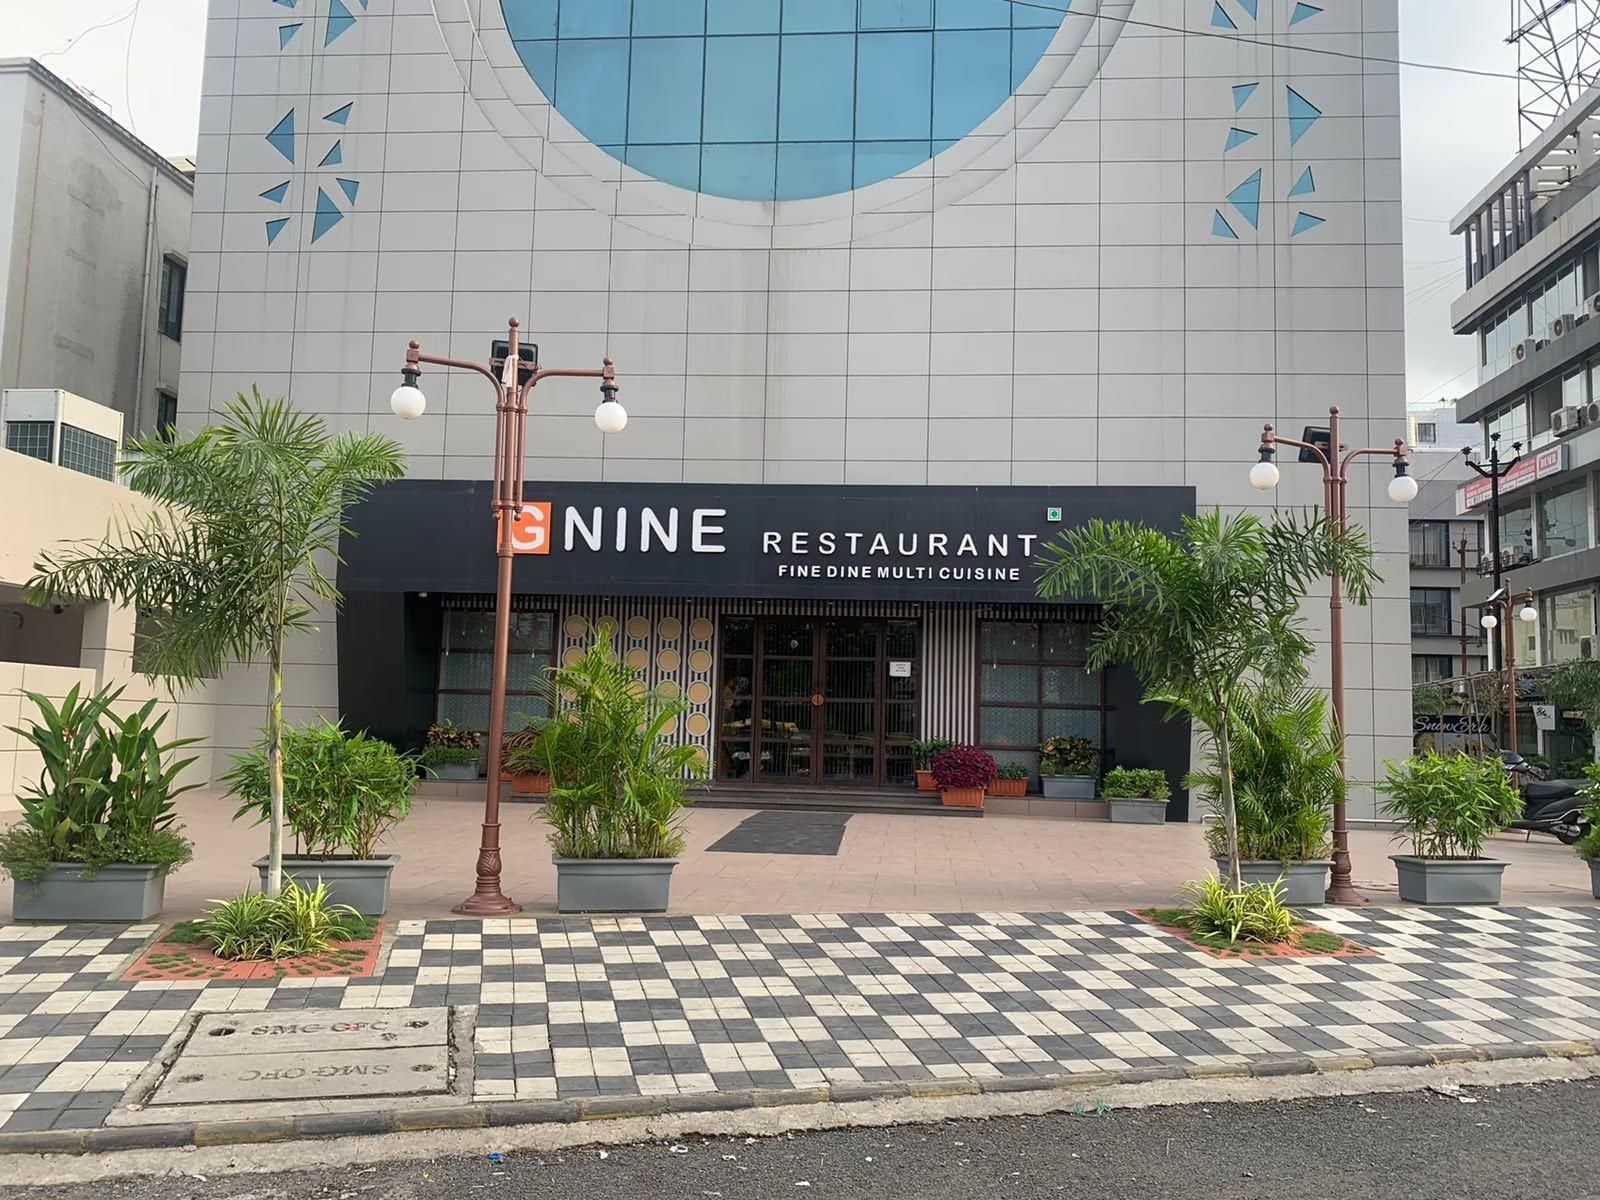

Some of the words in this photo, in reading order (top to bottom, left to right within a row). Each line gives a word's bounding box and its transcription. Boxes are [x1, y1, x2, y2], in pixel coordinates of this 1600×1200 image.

[511, 505, 545, 550] G
[563, 506, 727, 553] NINE
[762, 531, 1037, 557] RESTAURANT
[778, 565, 821, 578] FINE
[827, 565, 872, 578] DINE
[877, 566, 933, 579] MULTI
[939, 567, 1020, 581] CUISINE
